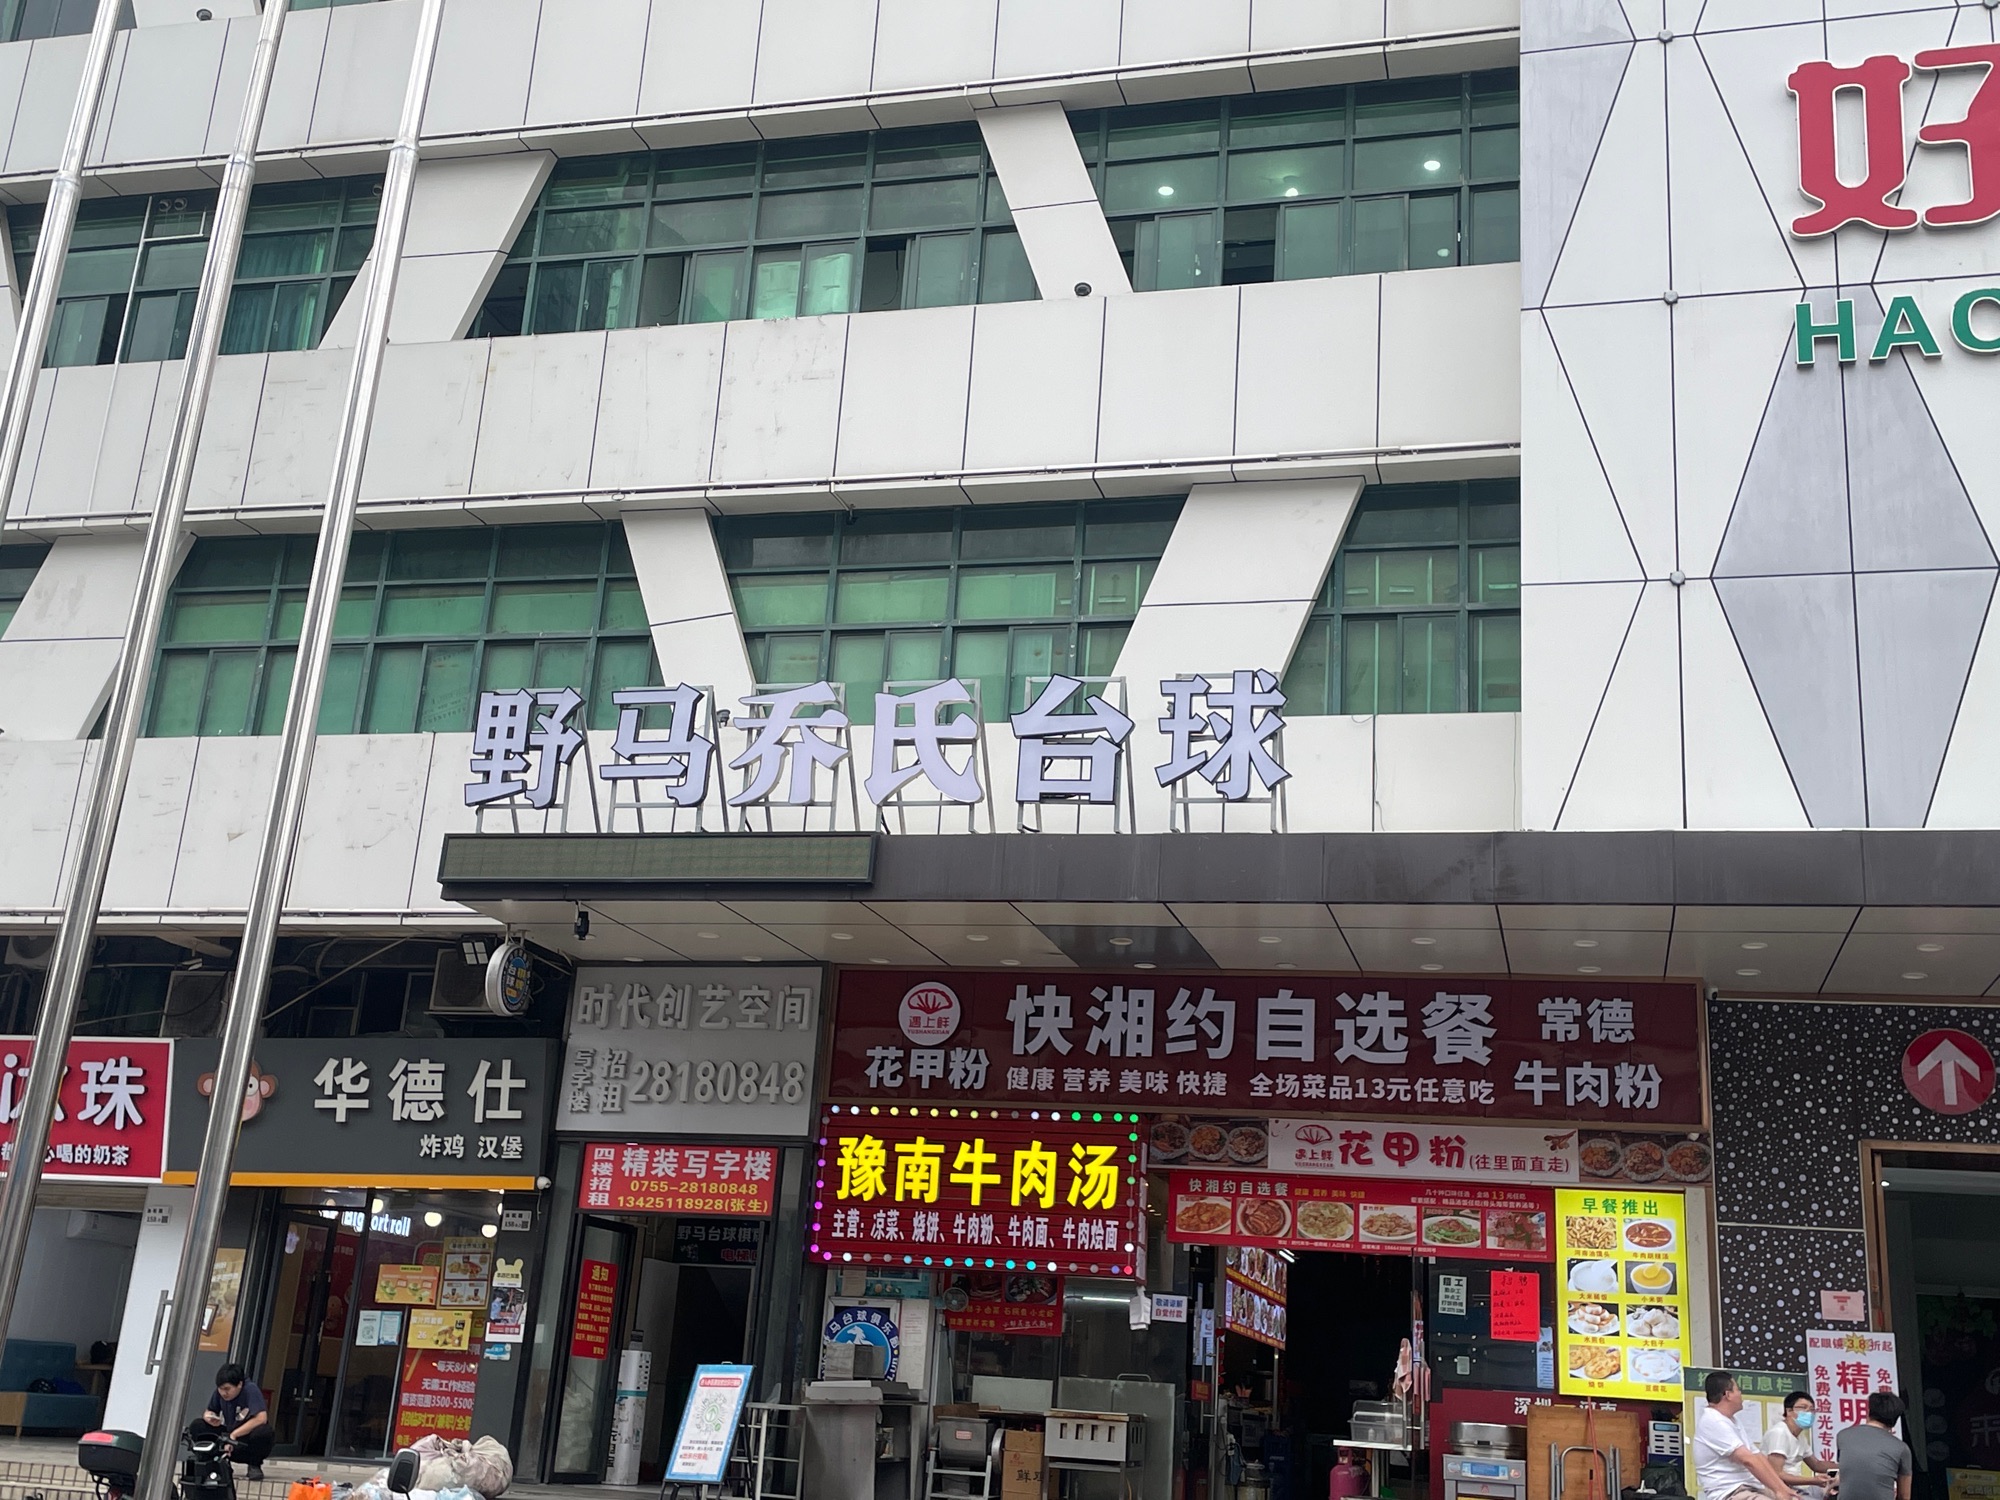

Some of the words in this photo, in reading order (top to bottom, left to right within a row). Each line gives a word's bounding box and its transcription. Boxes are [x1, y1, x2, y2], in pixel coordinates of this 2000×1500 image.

[465, 669, 1291, 809] 野马乔氏台球
[576, 983, 812, 1031] 时代创艺空间
[908, 1015, 950, 1029] 遇上鲜
[1005, 983, 1498, 1067] 快湘约自选餐
[1537, 997, 1635, 1043] 常德
[567, 1048, 596, 1113] 写字楼
[598, 1048, 629, 1113] 招租
[629, 1060, 805, 1105] 28180848
[864, 1046, 990, 1090] 花甲粉
[1006, 1066, 1055, 1092] 健康
[1063, 1067, 1111, 1093] 营养
[1119, 1068, 1169, 1094] 美味
[1176, 1070, 1227, 1096] 快捷
[1249, 1073, 1496, 1105] 全场菜品13元任意吃
[1514, 1060, 1662, 1109] 牛肉粉
[313, 1057, 526, 1125] 华德仕
[419, 1134, 465, 1159] 炸鸡
[477, 1135, 523, 1160] 汉堡
[621, 1147, 772, 1182] 精装写字楼
[1338, 1129, 1467, 1168] 花甲粉
[1469, 1154, 1569, 1174] (往里面直走)
[587, 1148, 615, 1207] 四楼招租
[630, 1180, 758, 1195] 0755-28180848
[836, 1134, 1119, 1210] 豫南牛肉汤
[1188, 1178, 1289, 1197] 快湘约自选餐
[617, 1196, 769, 1214] 13425118928(张生)
[1582, 1197, 1658, 1216] 早餐推出
[1643, 1339, 1665, 1347] 大包子
[401, 1392, 474, 1411] 薪资范围3500-5500
[1814, 1364, 1835, 1462] 免费验光专业
[1836, 1361, 1870, 1427] 精明
